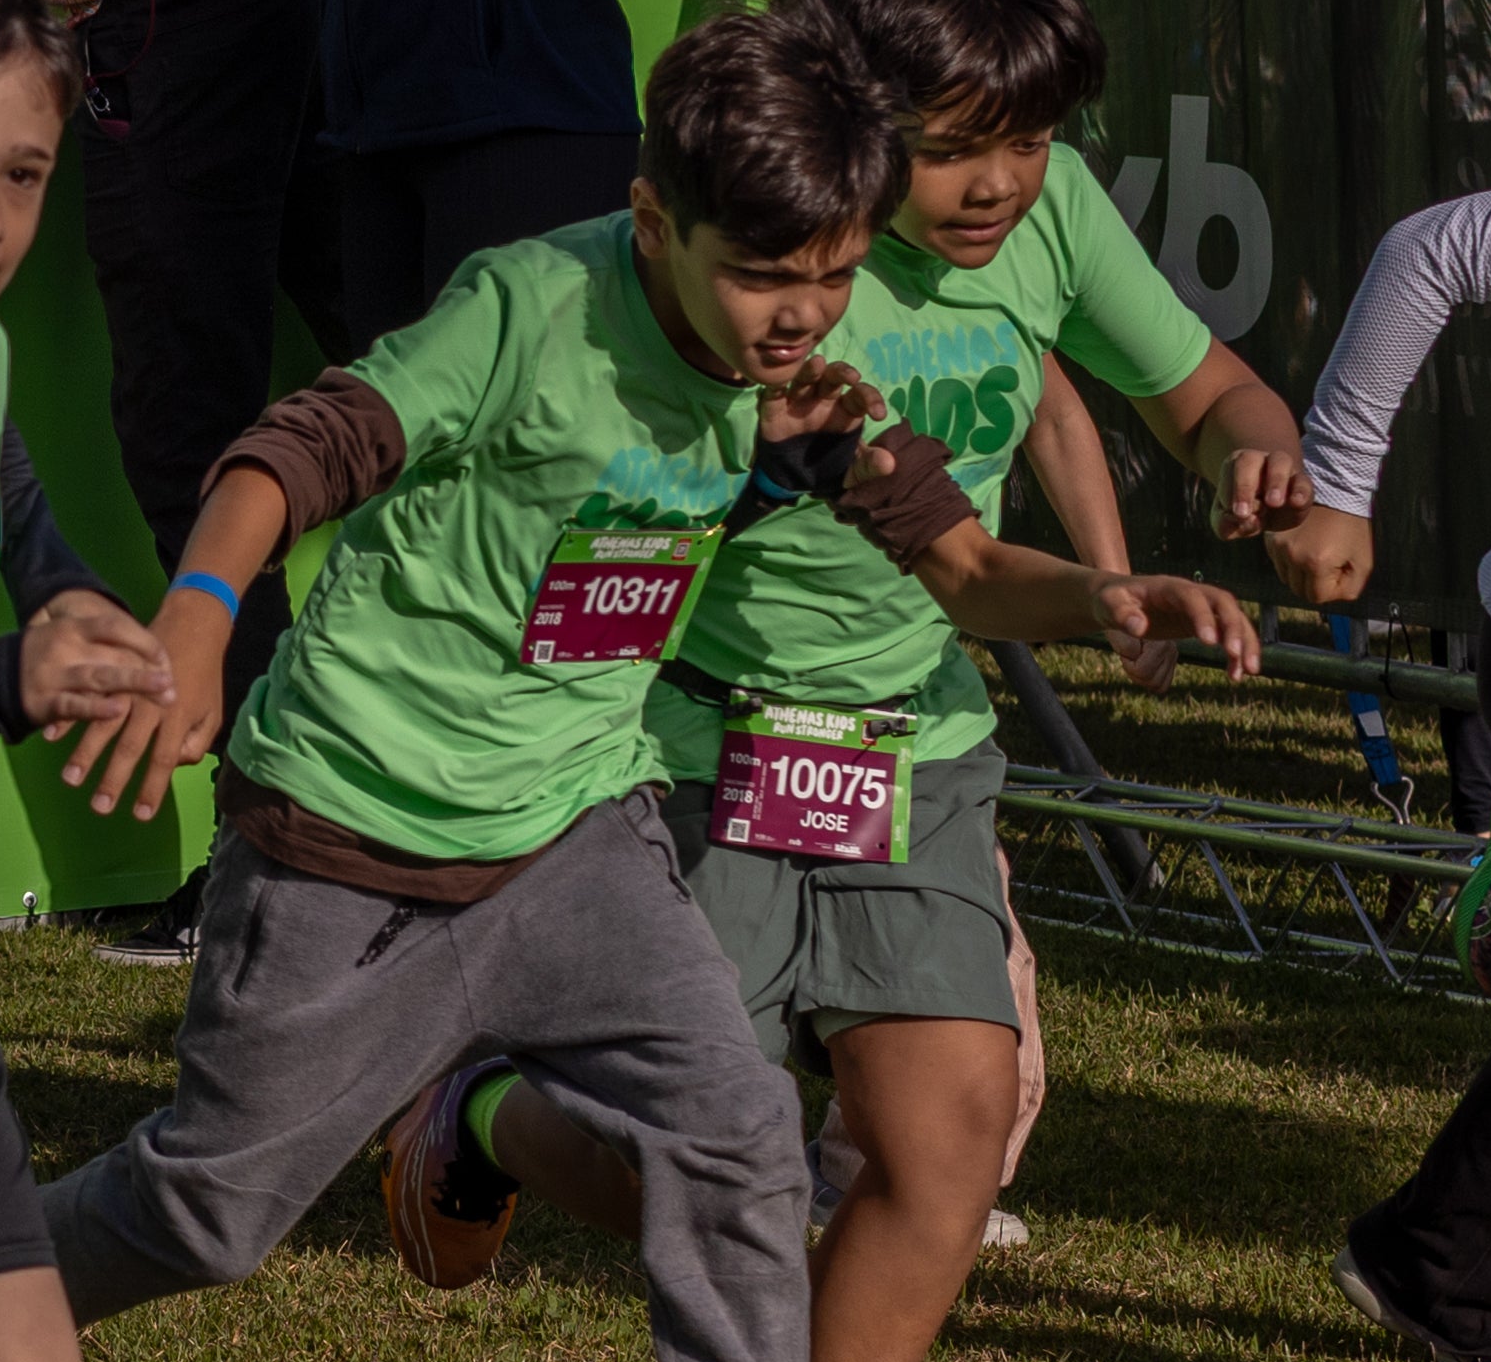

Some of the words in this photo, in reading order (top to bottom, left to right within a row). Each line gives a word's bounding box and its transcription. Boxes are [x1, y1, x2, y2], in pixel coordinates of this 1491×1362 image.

[867, 321, 1019, 385] ATHENAS
[590, 536, 642, 551] ATHENAS
[643, 536, 672, 551] KIDS
[549, 580, 577, 592] 100m
[582, 575, 681, 616] 10311
[533, 612, 563, 626] 2018
[764, 705, 824, 728] ATHENAS
[825, 710, 856, 732] KIDS
[773, 722, 796, 734] RUN
[796, 724, 844, 741] STRONGER
[729, 752, 762, 768] 100m
[771, 755, 887, 810] 10075
[722, 787, 754, 804] 2018
[800, 810, 850, 833] JOSE
